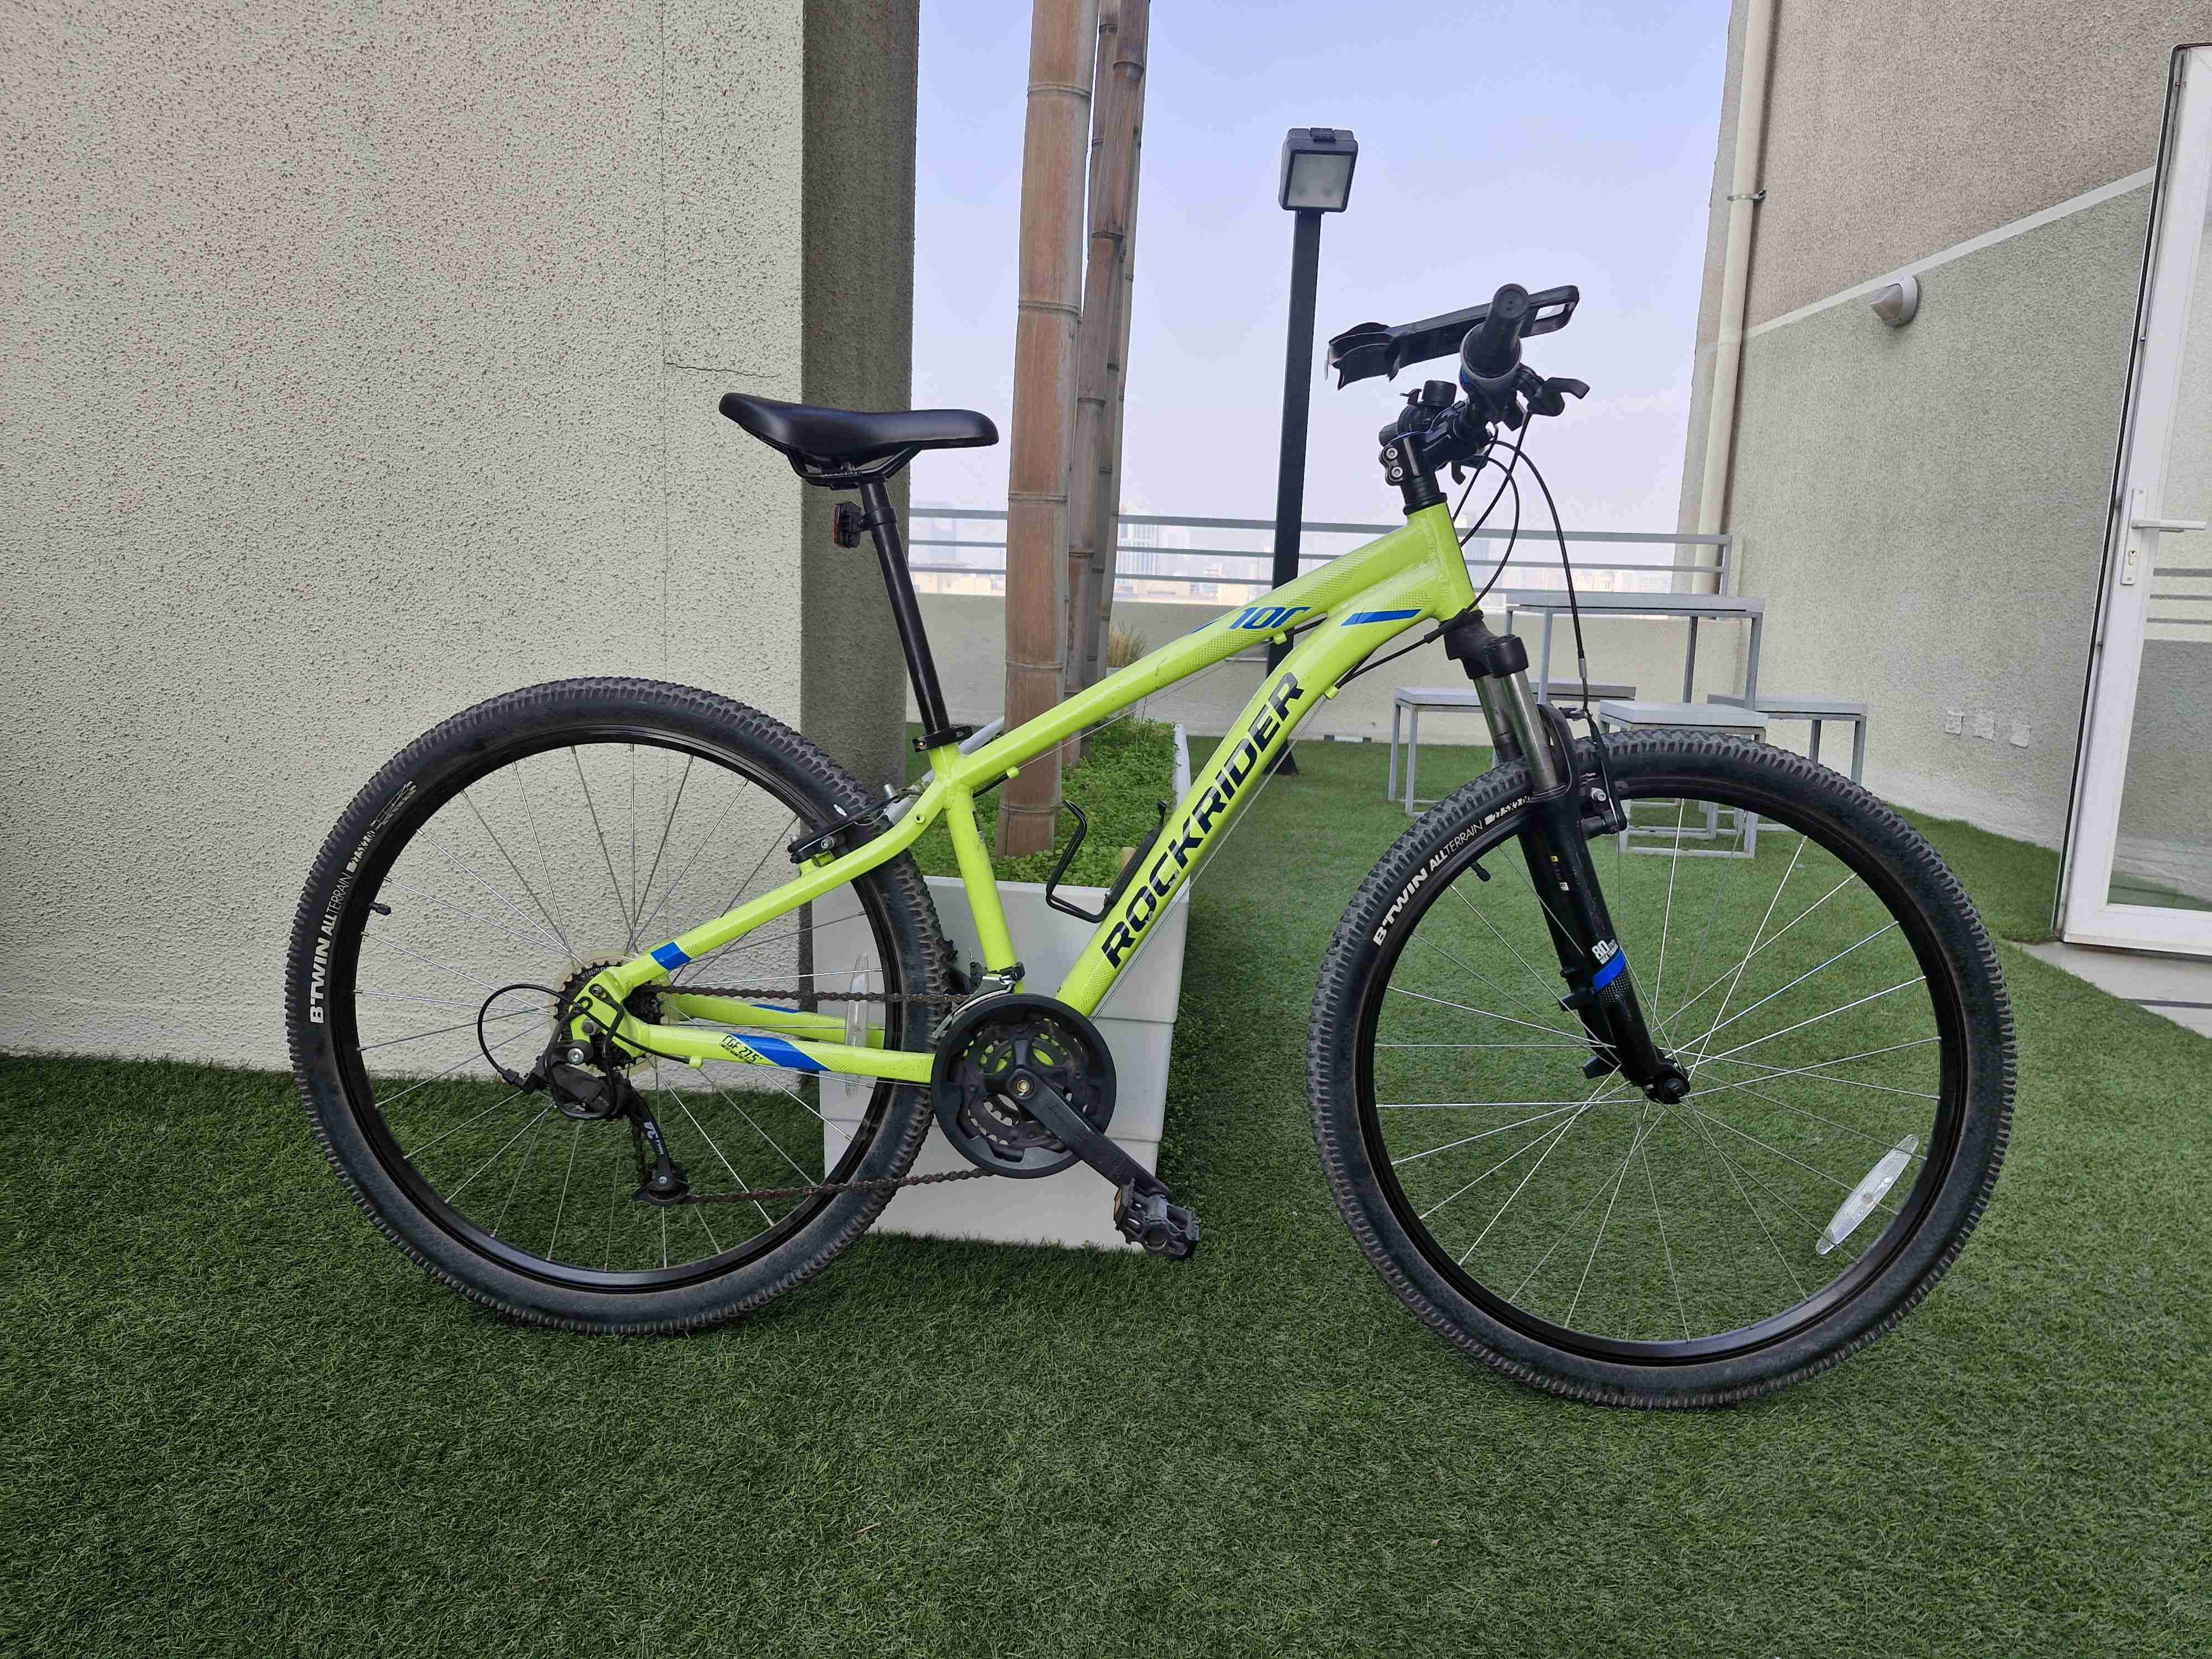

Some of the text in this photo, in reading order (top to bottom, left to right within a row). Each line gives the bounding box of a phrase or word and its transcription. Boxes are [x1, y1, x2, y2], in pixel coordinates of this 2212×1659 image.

[1102, 672, 1305, 969] ROCKRIDER
[1373, 868, 1428, 946] B'TWIN
[310, 937, 331, 1024] B'TWIN
[1592, 940, 1610, 959] 80
